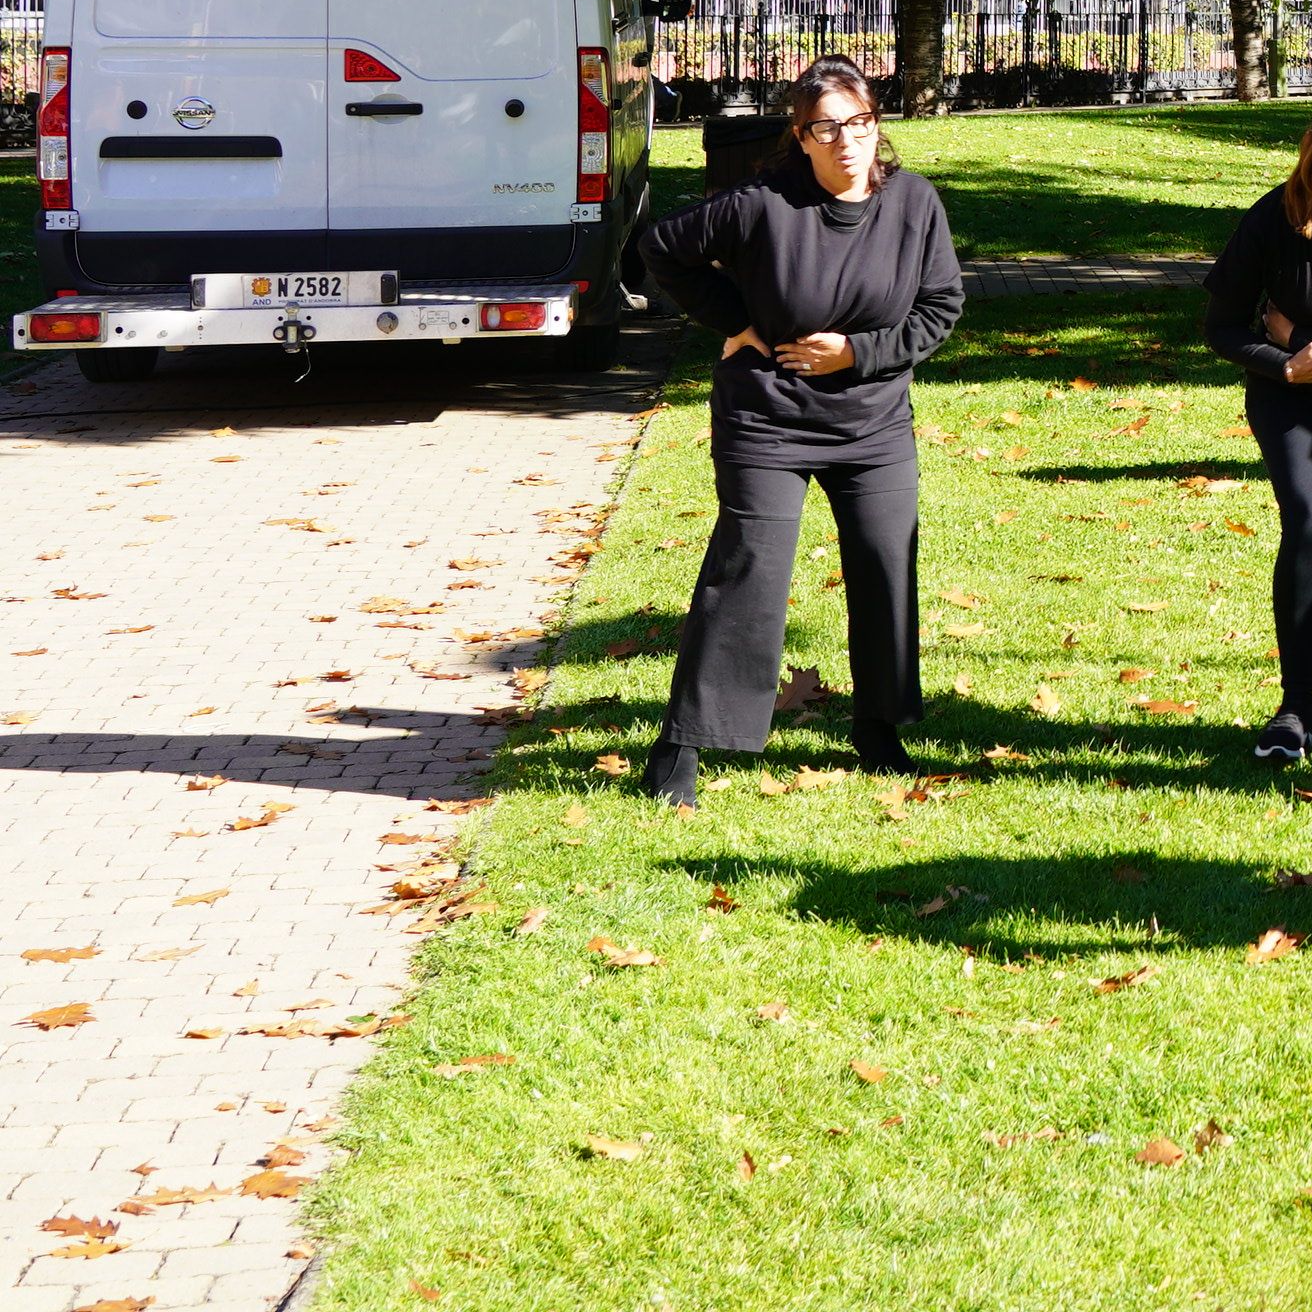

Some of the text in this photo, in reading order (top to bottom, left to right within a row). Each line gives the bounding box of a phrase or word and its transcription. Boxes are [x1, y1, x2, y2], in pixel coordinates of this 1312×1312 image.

[492, 182, 556, 194] NV400
[278, 277, 342, 297] N 2582
